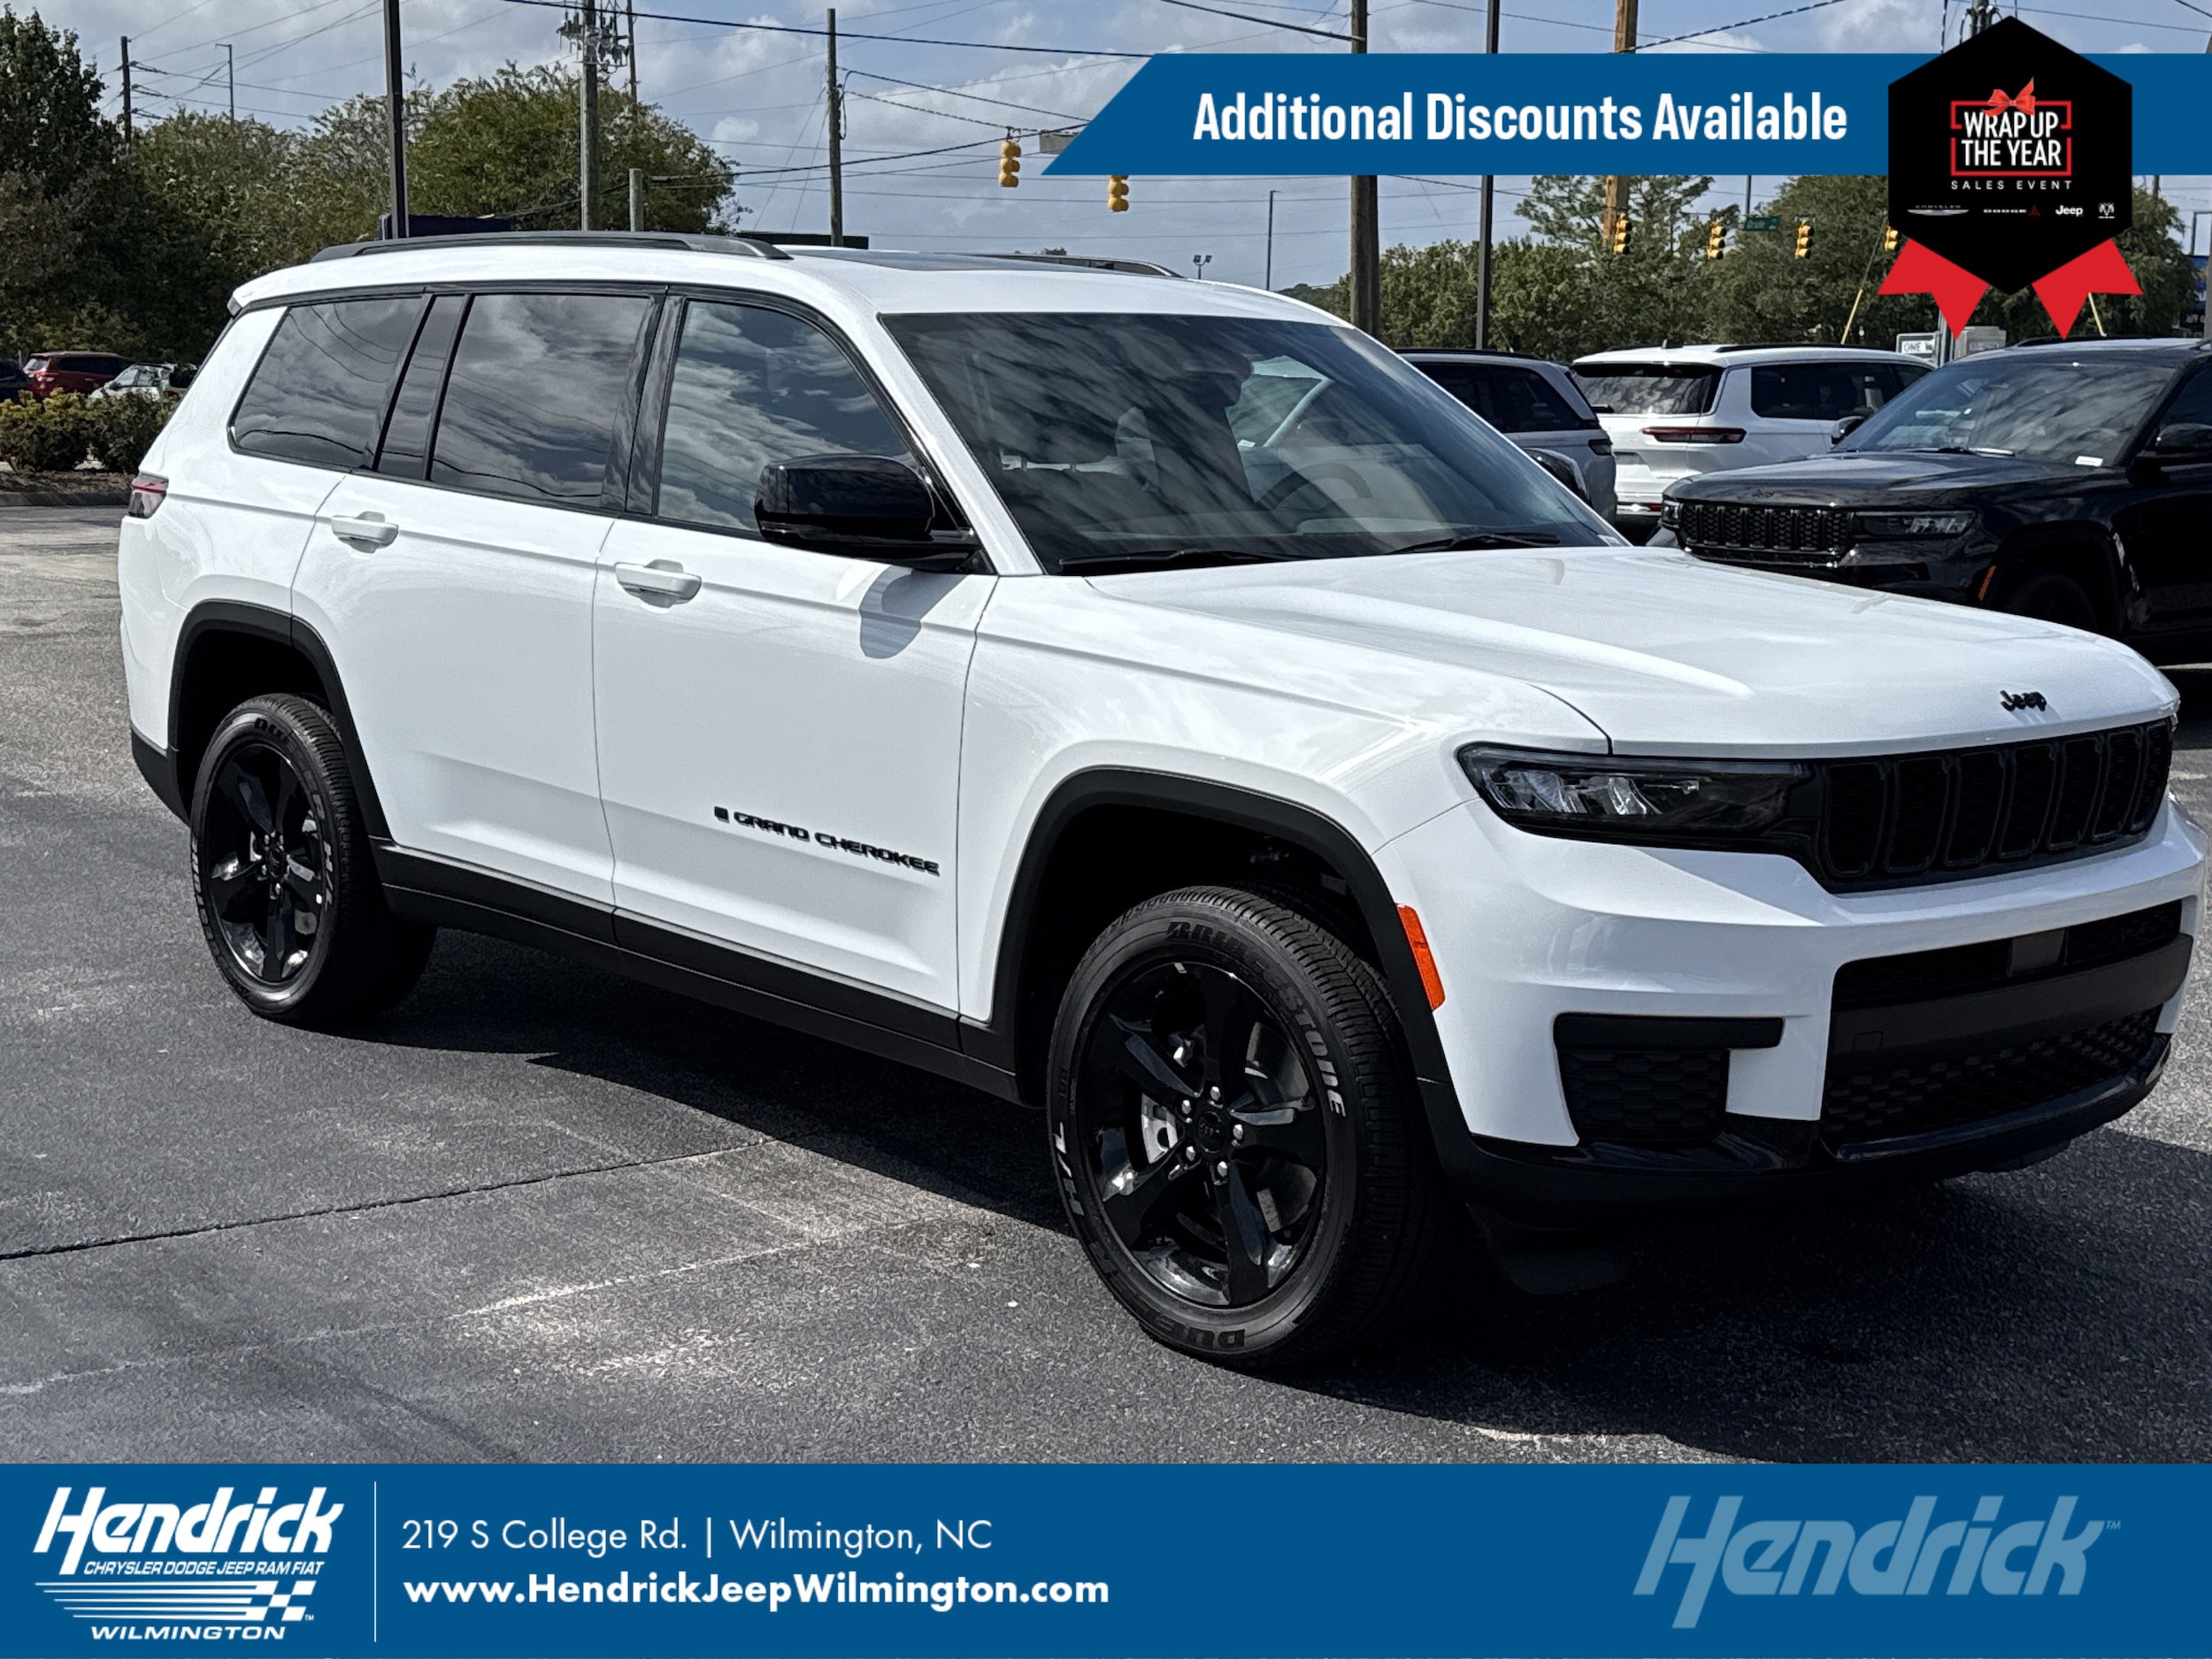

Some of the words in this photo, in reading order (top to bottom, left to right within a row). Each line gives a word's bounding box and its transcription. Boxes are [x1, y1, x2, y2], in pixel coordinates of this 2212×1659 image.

[1903, 342, 1922, 352] ONE
[2000, 689, 2047, 711] Jeep
[733, 811, 810, 841] GRAND
[814, 832, 941, 876] CHEROKEE
